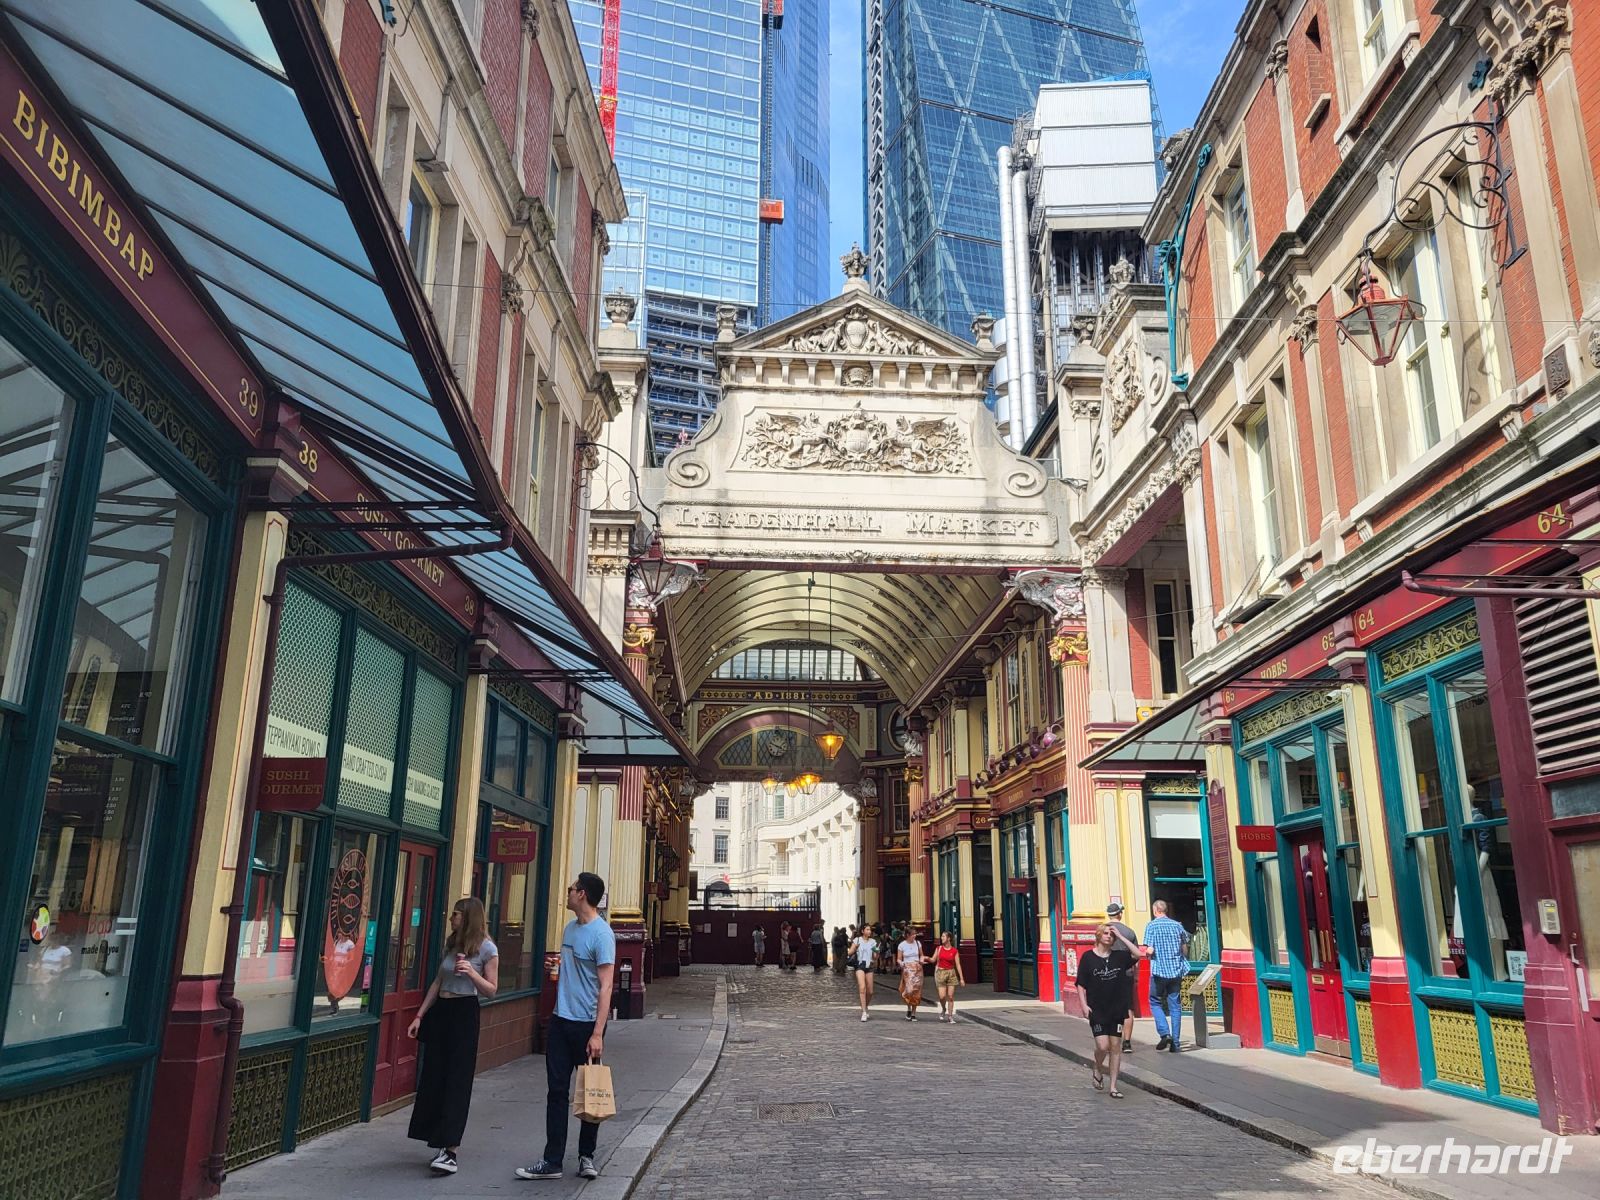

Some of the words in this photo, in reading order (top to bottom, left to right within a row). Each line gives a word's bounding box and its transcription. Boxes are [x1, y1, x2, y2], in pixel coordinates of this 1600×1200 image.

[12, 89, 154, 281] BIBIMBAP
[238, 377, 259, 418] 39
[298, 440, 319, 474] 38
[676, 506, 882, 532] LEADENHALL
[905, 511, 1041, 538] MARKET
[1537, 503, 1566, 534] 64
[464, 594, 475, 616] 38
[1358, 608, 1375, 631] 64
[1260, 659, 1288, 679] HOBBS
[1224, 689, 1235, 704] 65
[267, 770, 311, 780] SUSHI
[975, 816, 987, 824] 26
[81, 945, 98, 955] made
[107, 945, 119, 956] you
